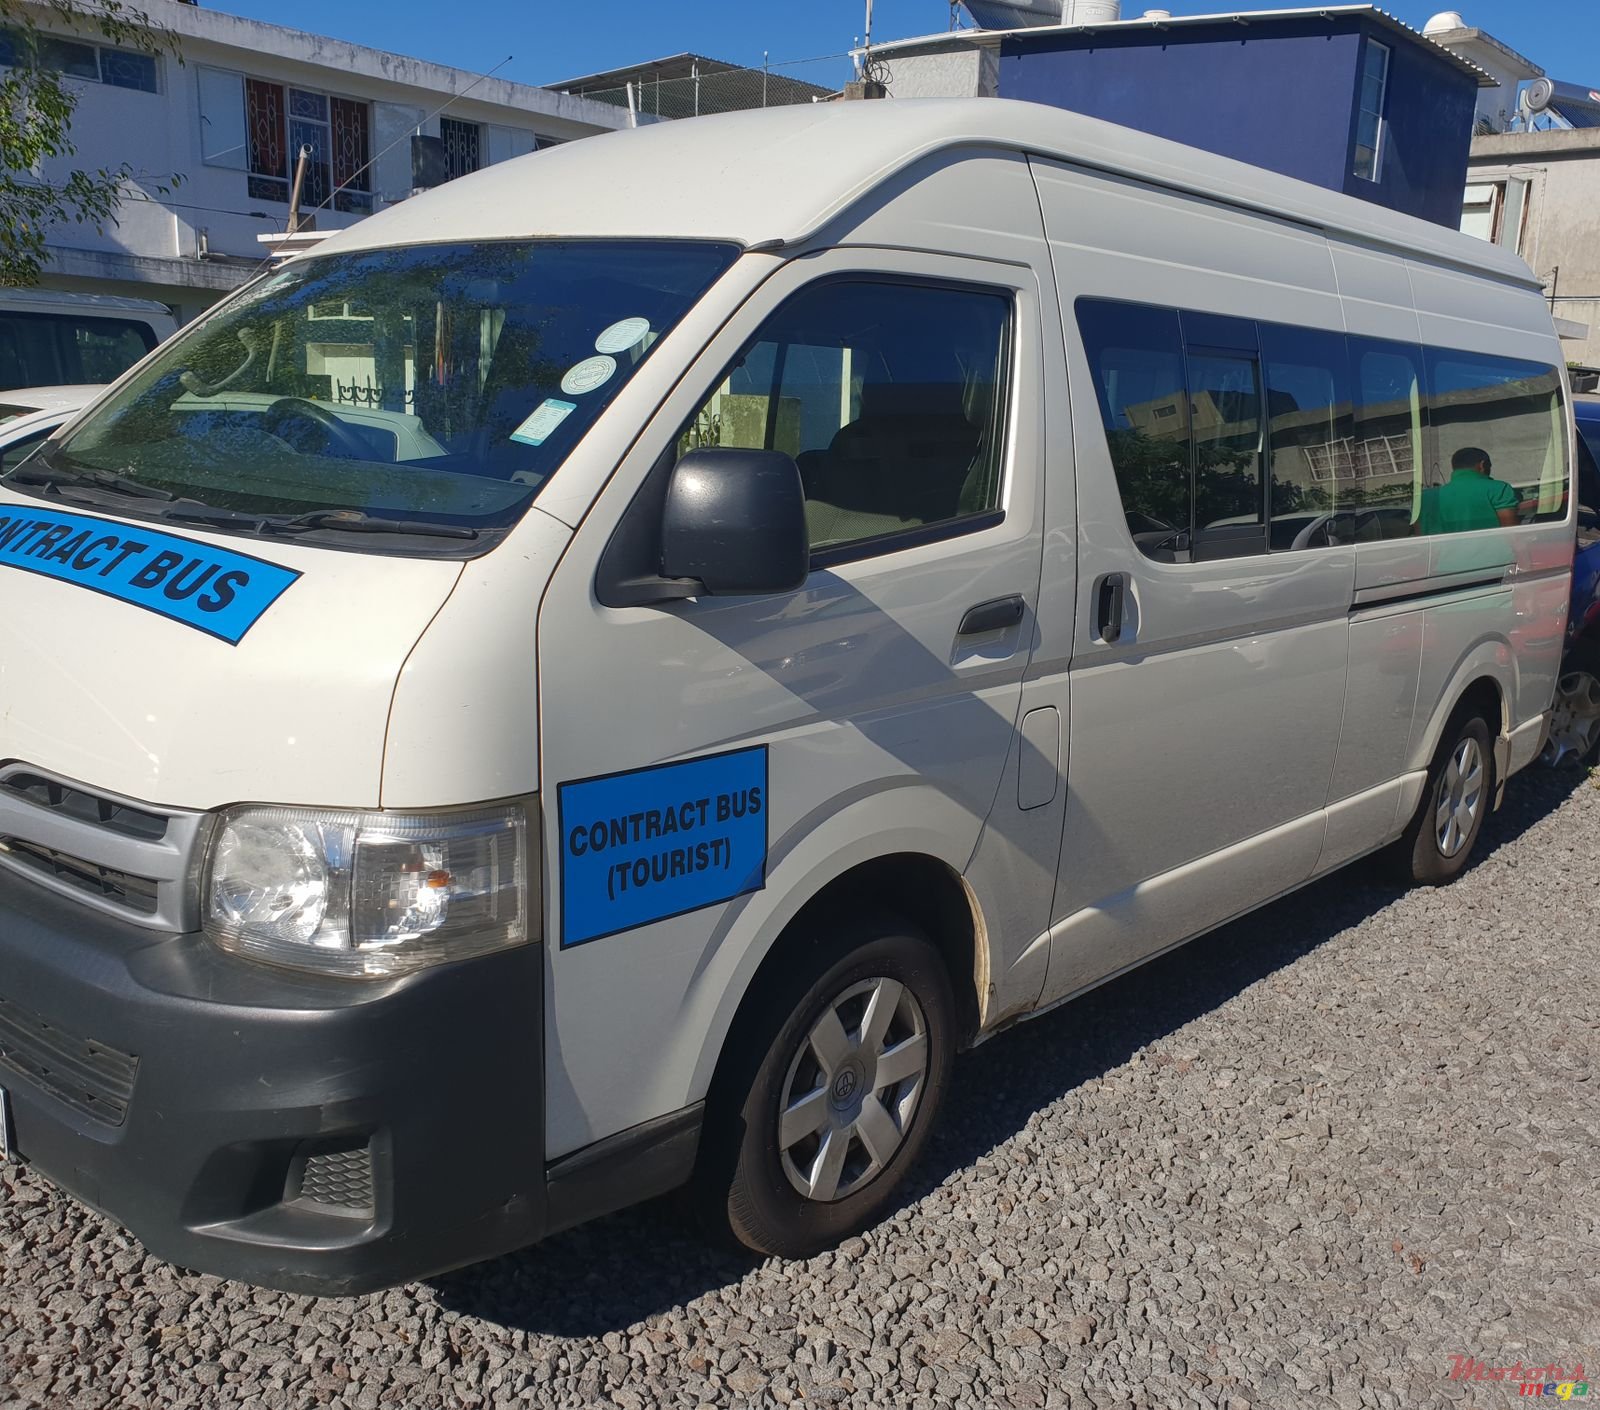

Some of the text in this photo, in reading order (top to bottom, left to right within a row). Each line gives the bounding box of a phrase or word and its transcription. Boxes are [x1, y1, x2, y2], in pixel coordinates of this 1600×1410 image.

[128, 550, 250, 612] BUS
[569, 787, 762, 857] CONTRACT BUS
[607, 837, 731, 901] (TOURIST)
